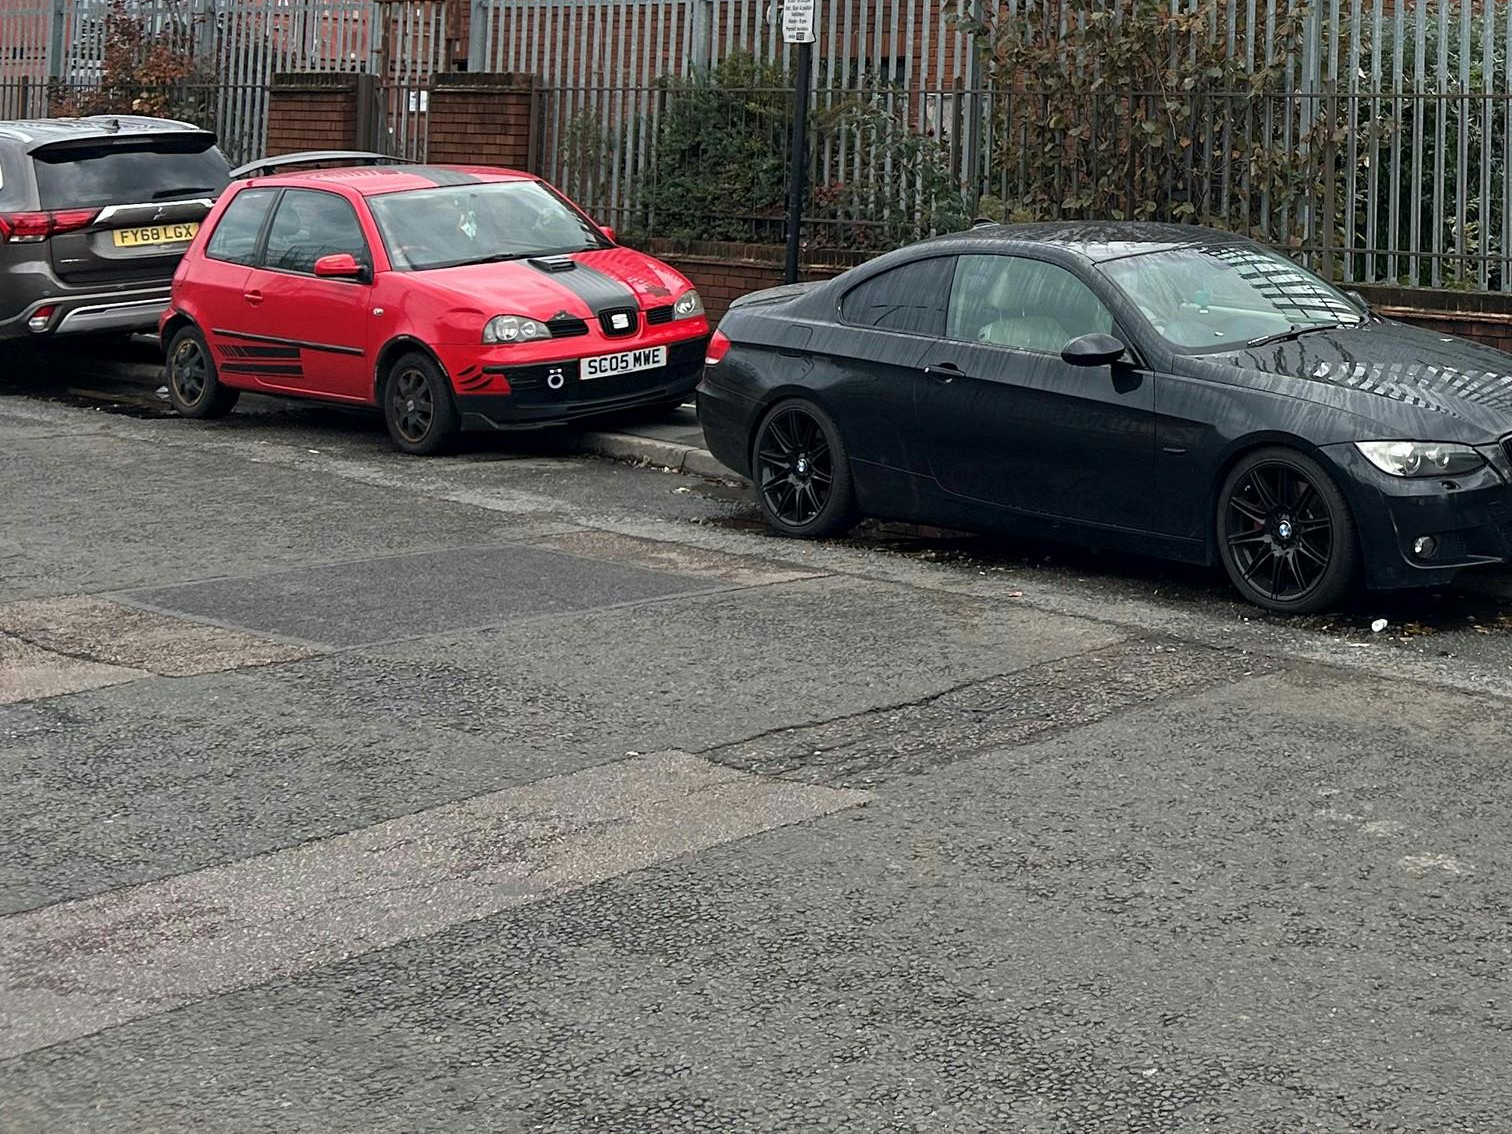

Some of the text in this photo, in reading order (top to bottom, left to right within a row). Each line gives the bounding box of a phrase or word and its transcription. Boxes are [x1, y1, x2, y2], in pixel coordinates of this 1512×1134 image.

[120, 224, 193, 244] FY68 LGX
[588, 348, 661, 375] SC05 MWE
